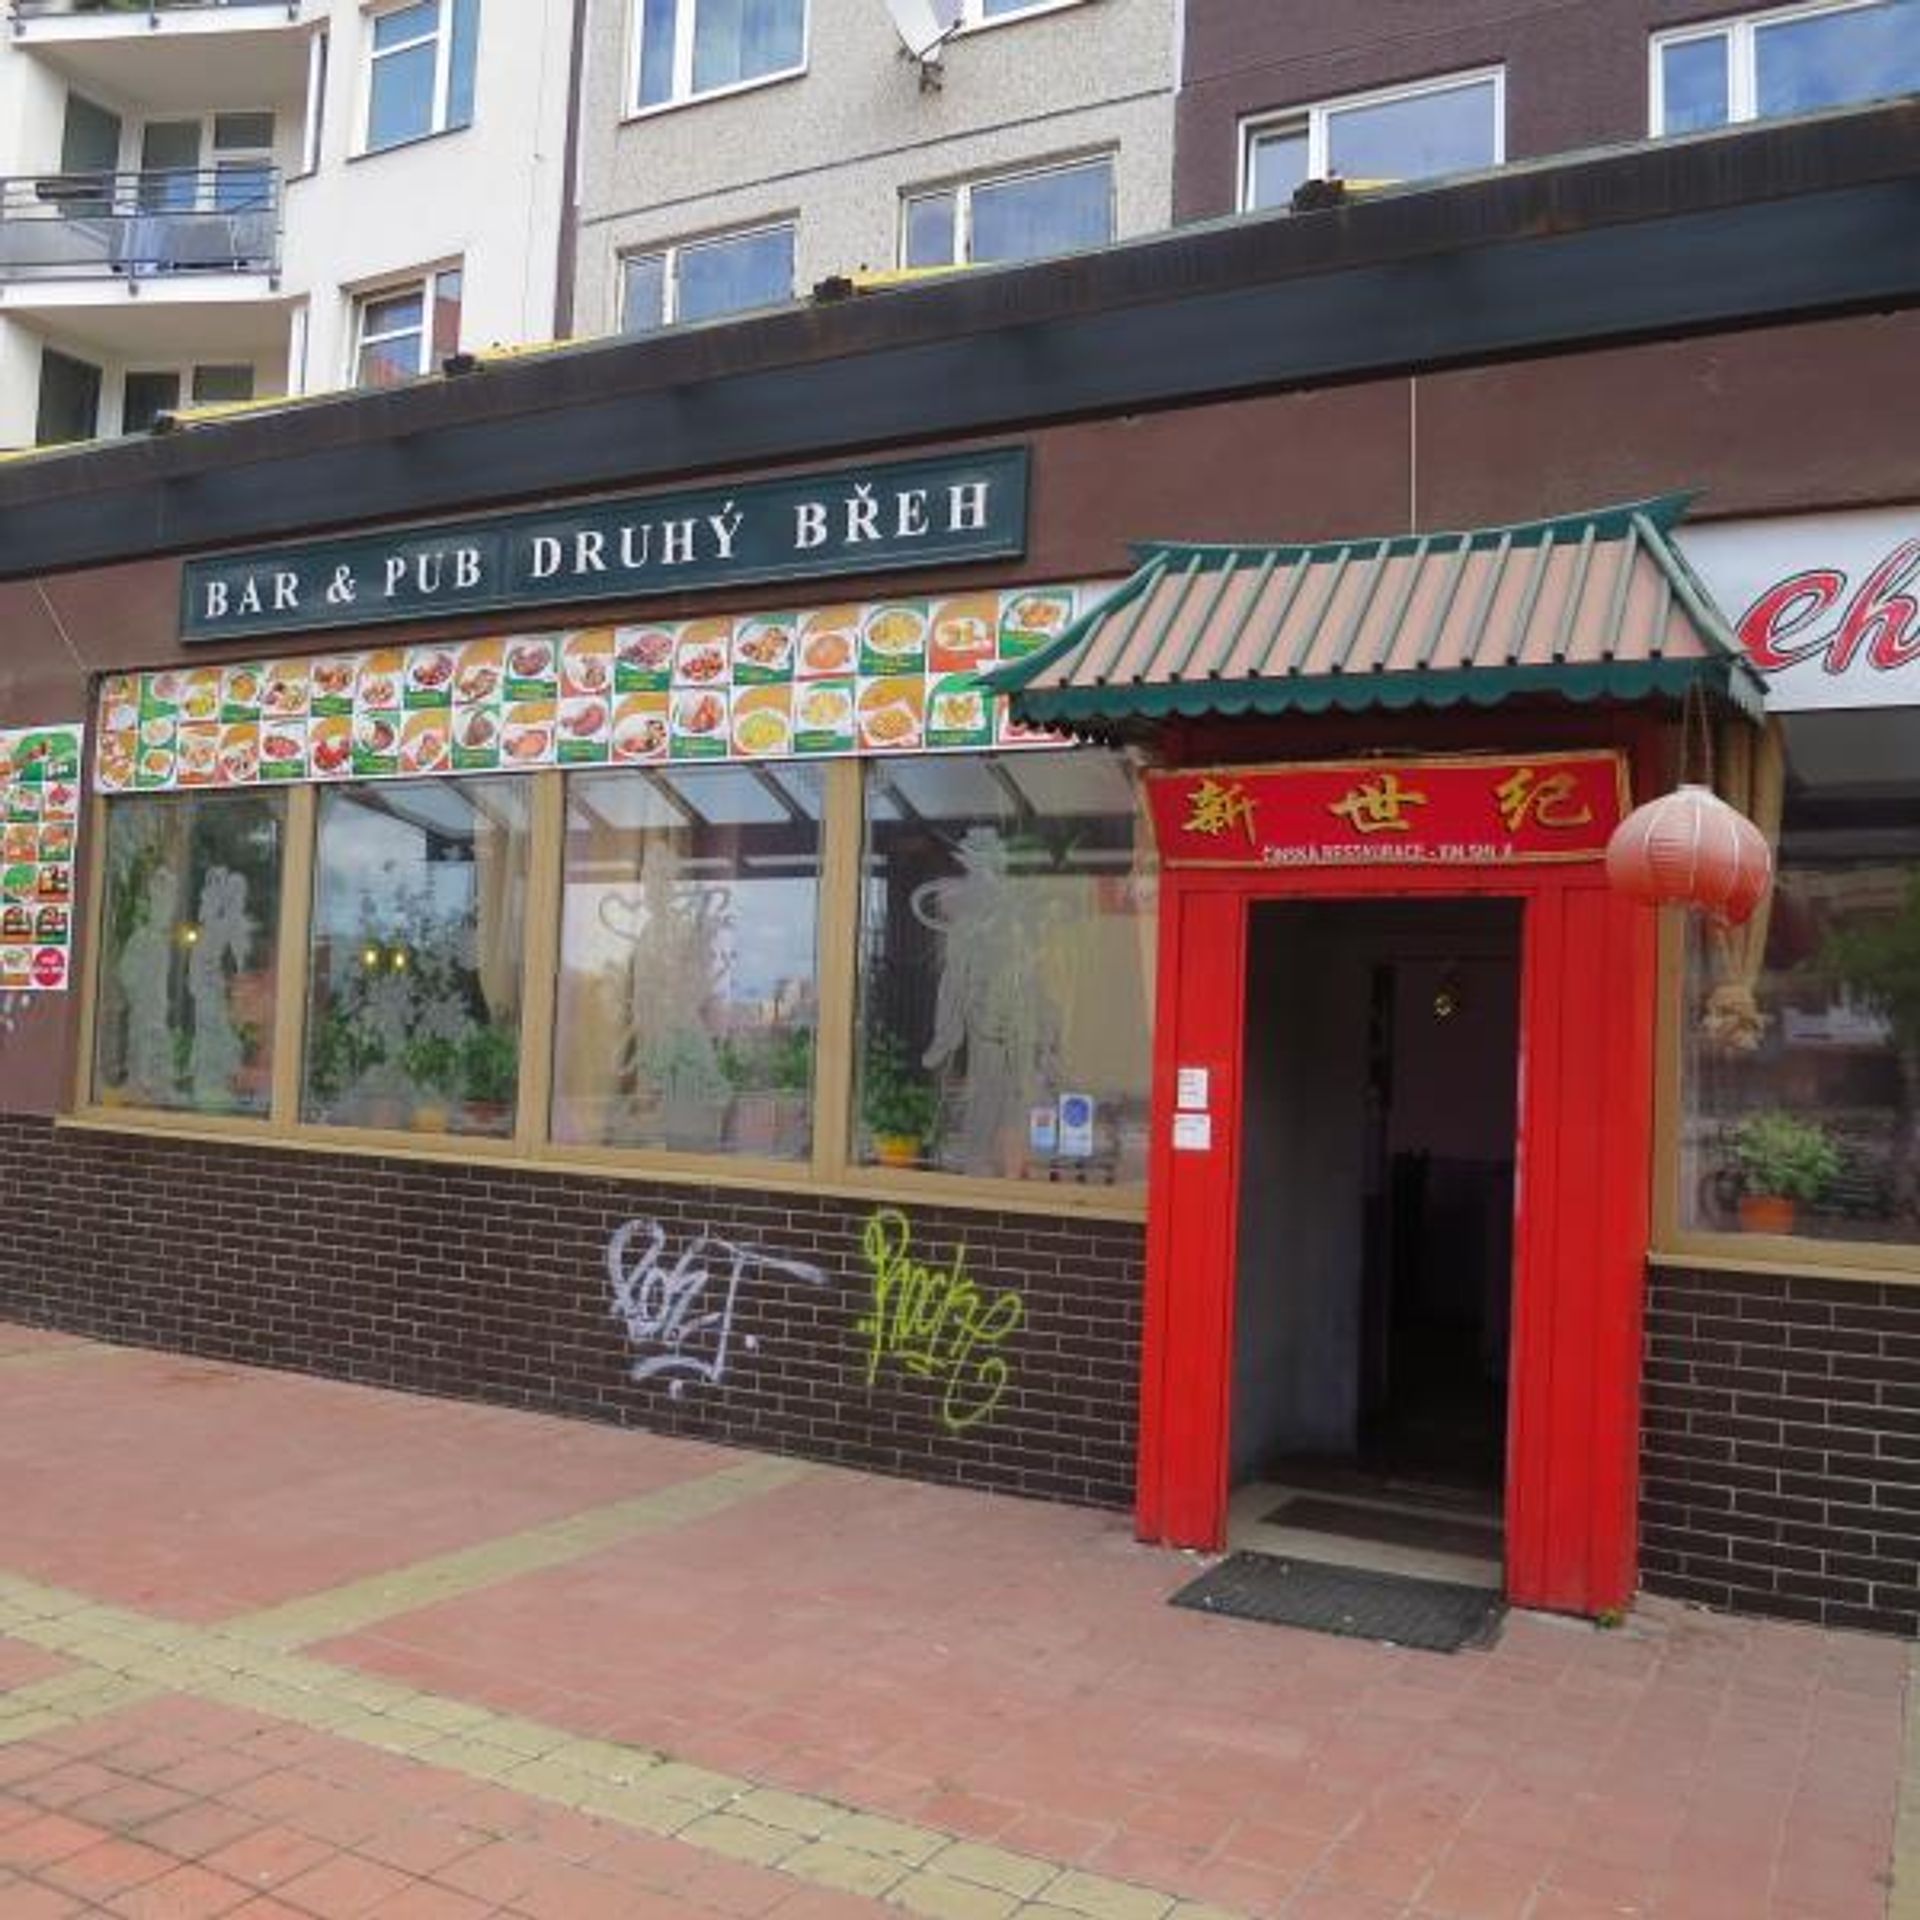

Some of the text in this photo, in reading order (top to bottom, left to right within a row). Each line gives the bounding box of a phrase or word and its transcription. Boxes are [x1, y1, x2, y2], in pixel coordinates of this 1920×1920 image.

[204, 482, 989, 619] BAR & PUB DRUHÝ BŘEH
